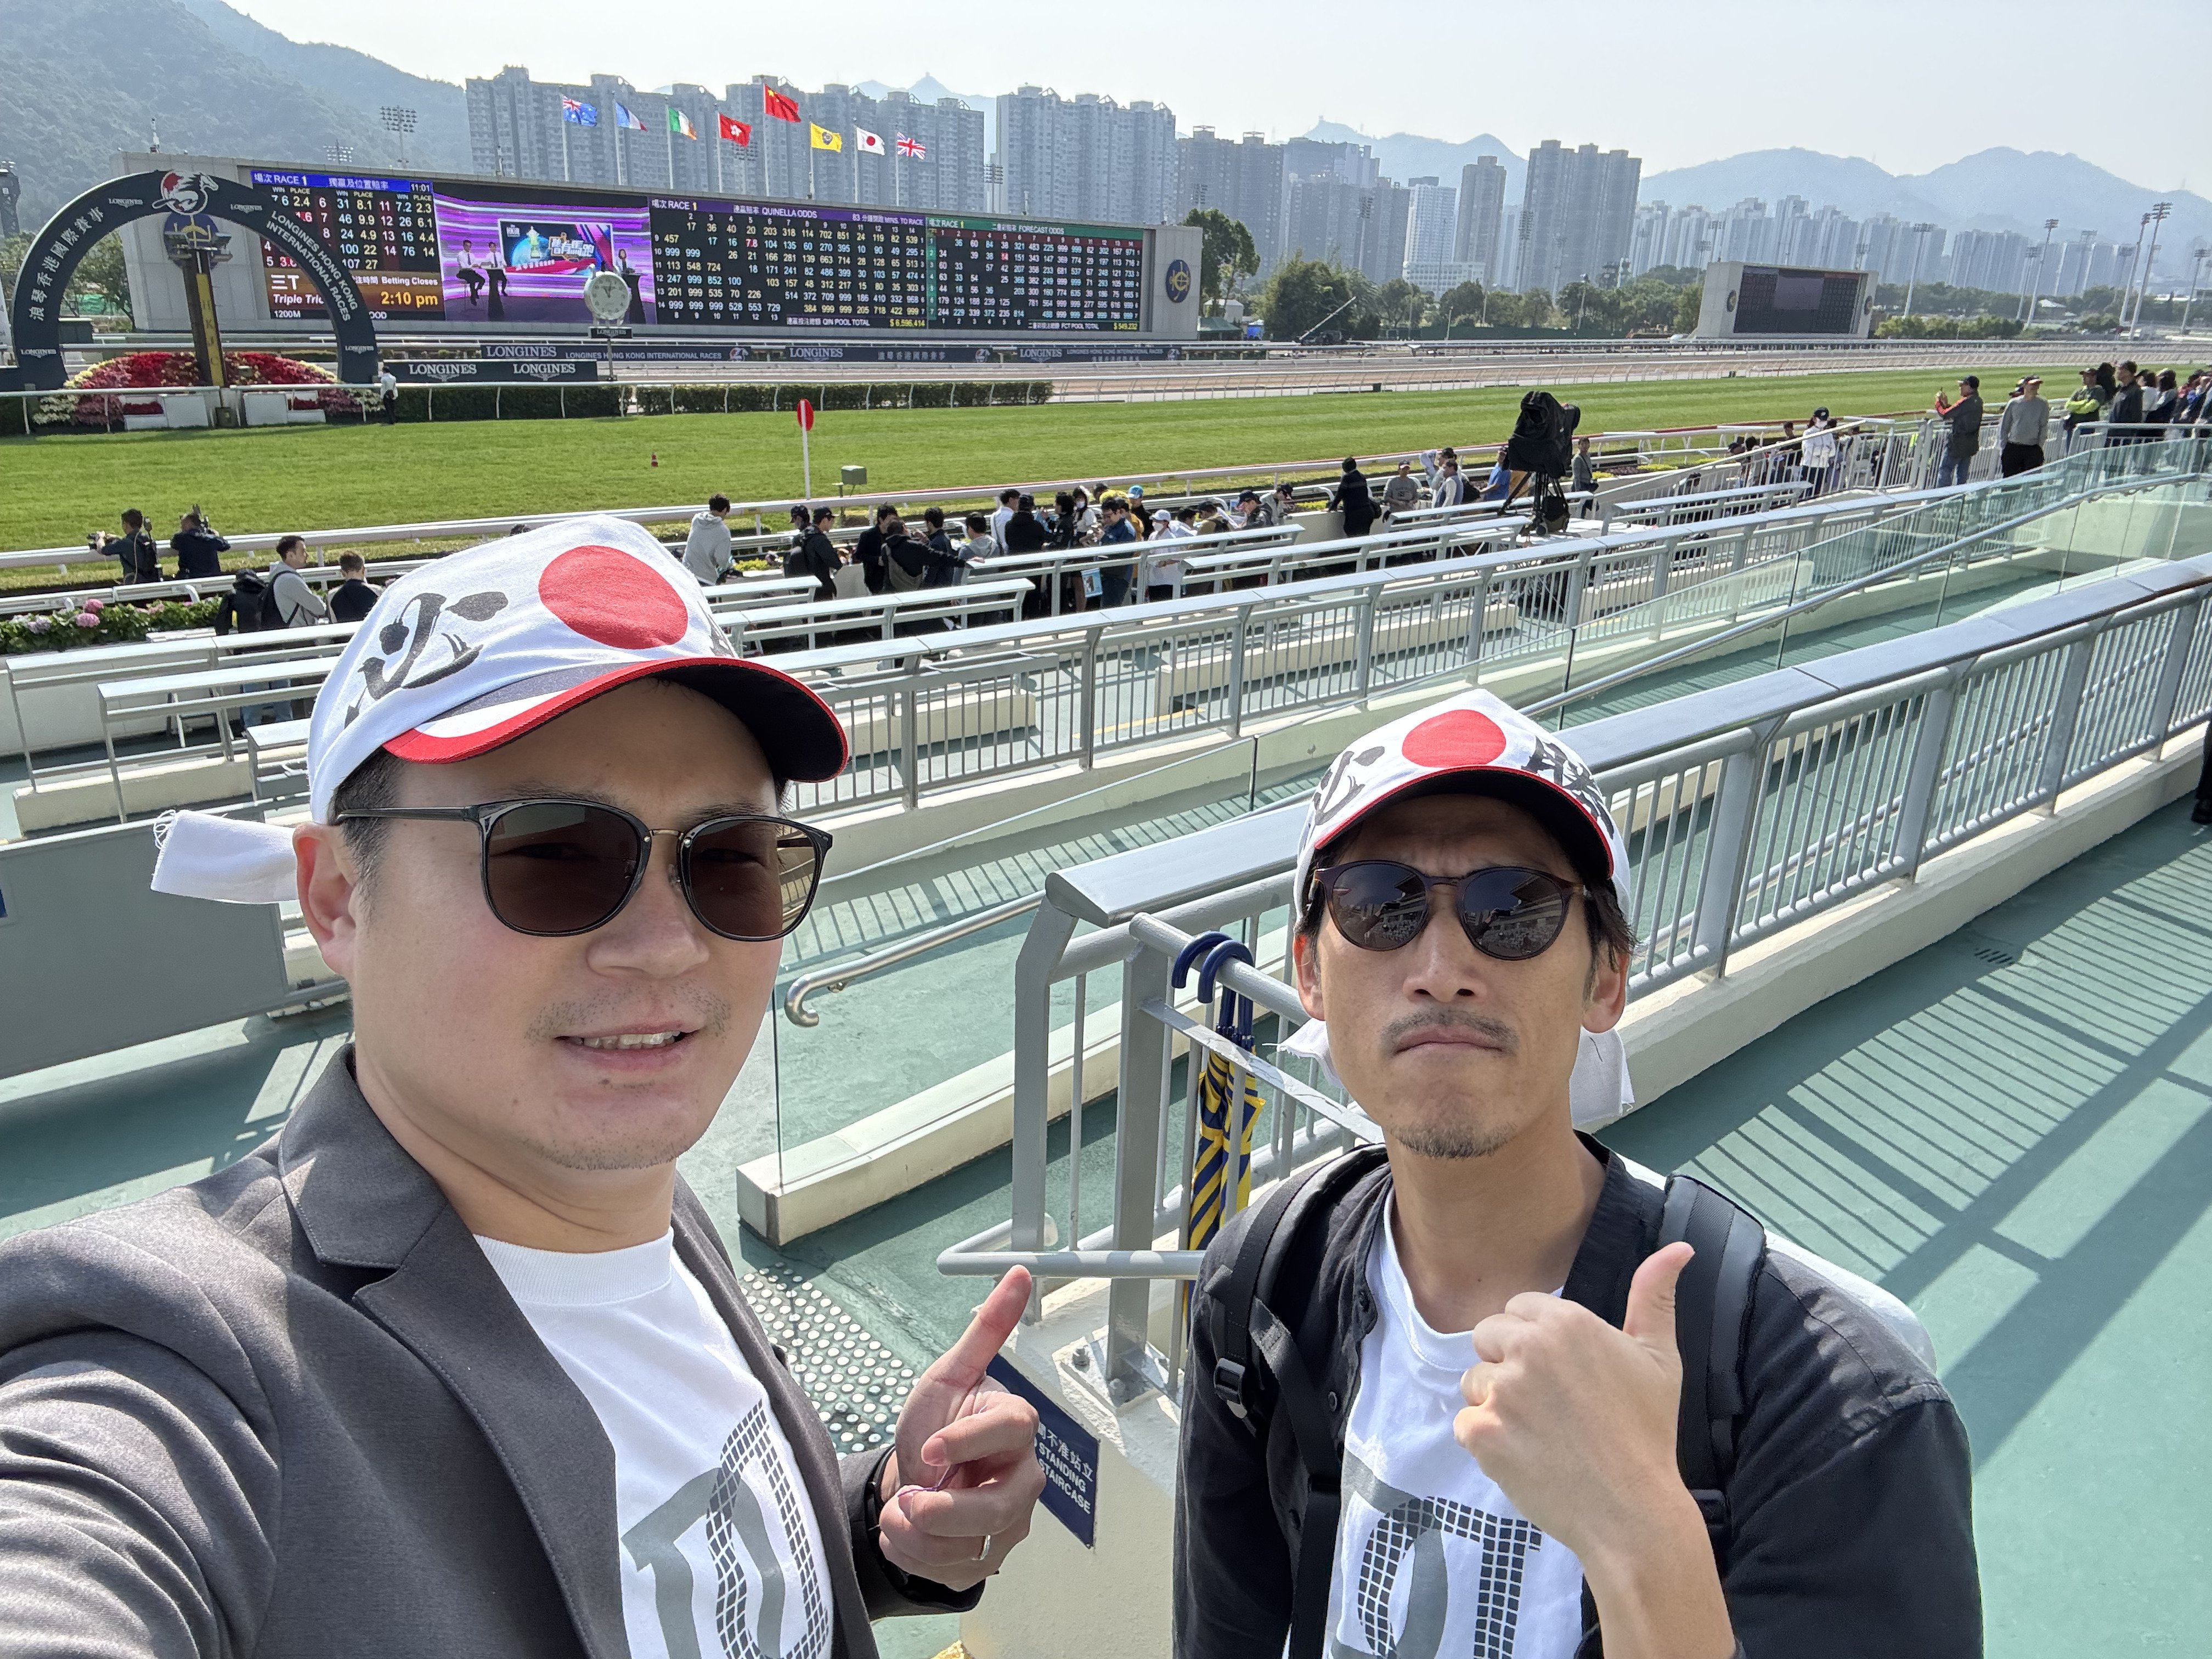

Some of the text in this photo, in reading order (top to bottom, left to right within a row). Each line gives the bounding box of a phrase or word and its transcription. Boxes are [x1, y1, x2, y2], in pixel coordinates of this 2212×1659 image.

[274, 175, 299, 184] RACE
[302, 176, 307, 185] 1
[294, 196, 310, 206] 2.4
[319, 198, 326, 207] 6
[337, 199, 348, 208] 31
[357, 200, 371, 210] 8.1
[380, 201, 390, 211] 11
[396, 202, 411, 212] 7.2
[416, 203, 431, 213] 2.3
[668, 200, 690, 210] RACE
[693, 202, 696, 211] 1
[761, 206, 797, 217] QUINELLA
[797, 210, 817, 219] ODDS
[321, 213, 327, 222] 7
[339, 214, 352, 223] 46
[359, 215, 374, 225] 9.9
[381, 216, 393, 226] 12
[399, 217, 411, 227] 26
[417, 218, 432, 228] 6.1
[323, 228, 435, 242] 8 24 4.9 13 16 4.4
[687, 222, 696, 230] 17
[707, 223, 716, 232] 36
[727, 224, 736, 233] 40
[747, 225, 755, 234] 20
[764, 227, 777, 235] 203
[664, 234, 679, 242] 457
[728, 238, 737, 246] 16
[264, 241, 434, 257] 4 100 22 14 76 14
[729, 251, 737, 259] 26
[267, 256, 273, 266] 5
[365, 259, 377, 269] 27
[271, 210, 358, 310] LONGINES HONG KONG
[266, 221, 351, 321] INTERNATIONAL RACES
[667, 261, 680, 269] 113
[687, 262, 701, 270] 548
[707, 263, 720, 271] 724
[766, 266, 777, 274] 171
[784, 266, 796, 274] 241
[382, 277, 410, 286] Betting
[667, 274, 681, 283] 247
[274, 294, 302, 305] Triple
[381, 291, 438, 307] 2:10 pm
[668, 287, 681, 296] 201
[709, 289, 723, 297] 535
[730, 290, 740, 298] 70
[748, 290, 761, 298] 226
[785, 291, 798, 300] 514
[748, 303, 761, 311] 553
[768, 303, 780, 312] 729
[486, 346, 557, 357] LONGINES
[789, 347, 843, 358] LONGINES
[1020, 348, 1062, 358] LONGINES
[409, 363, 575, 374] LONGINES LONGINES
[1039, 1442, 1086, 1493] STANDING
[1039, 1458, 1091, 1514] STAIRCASE
